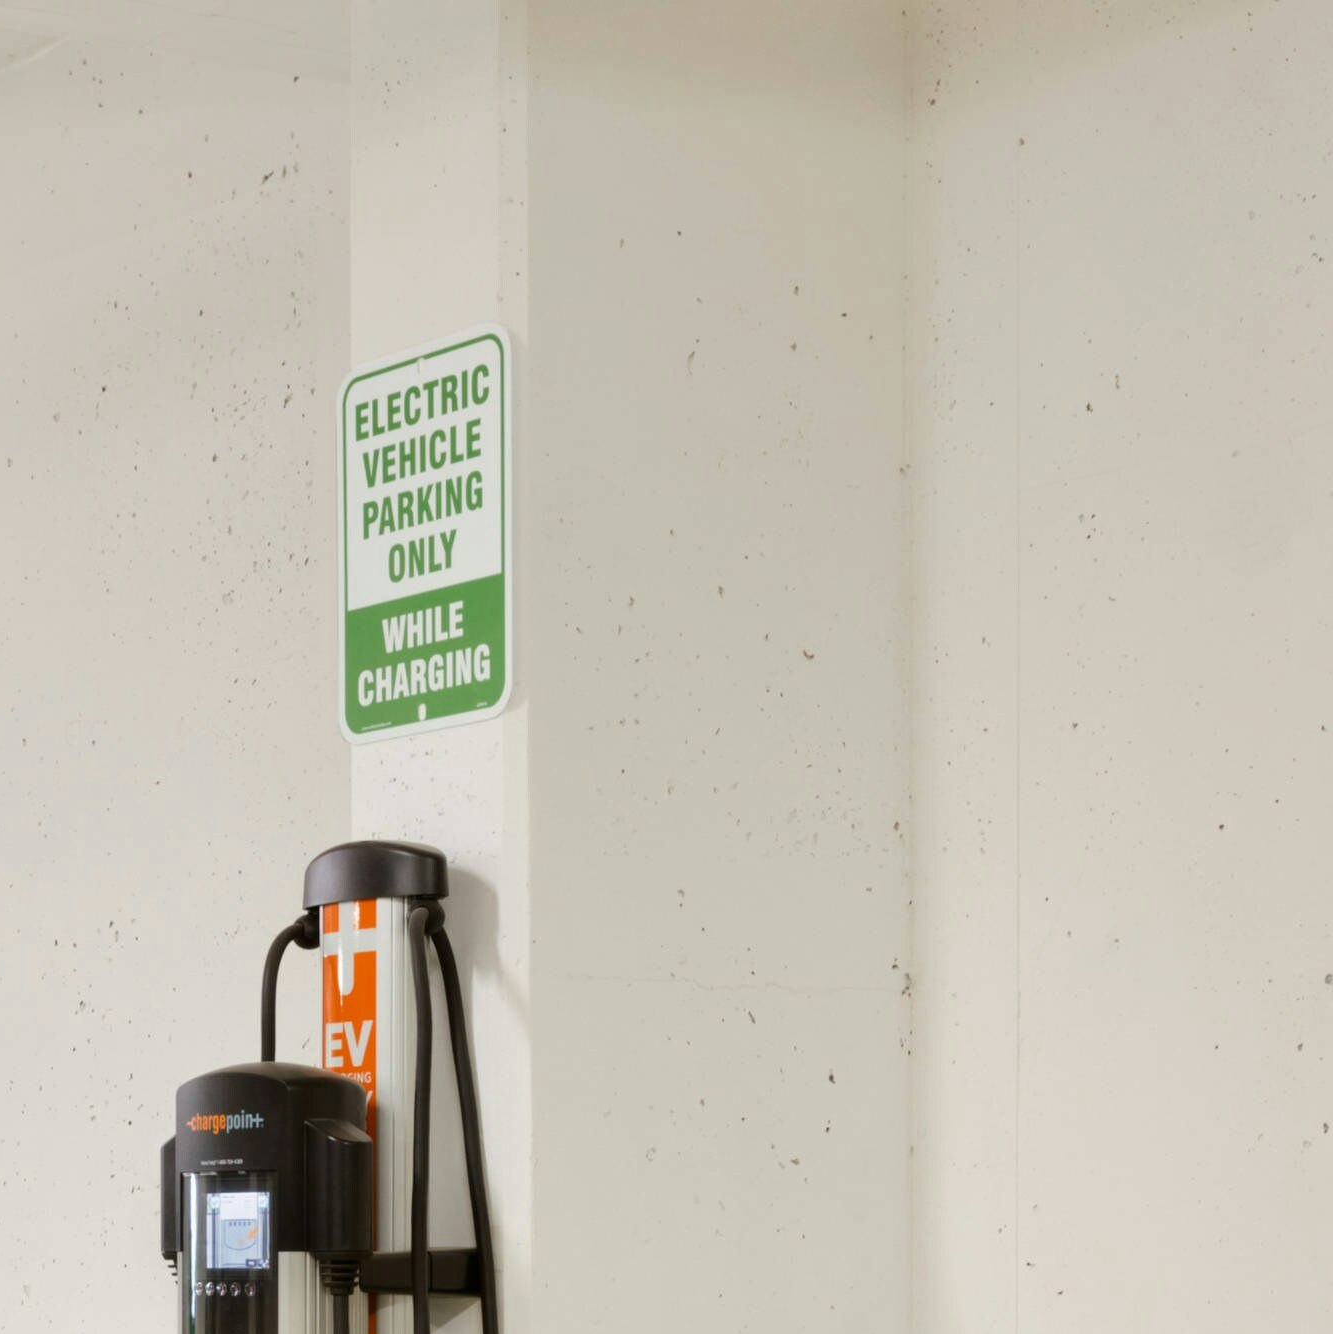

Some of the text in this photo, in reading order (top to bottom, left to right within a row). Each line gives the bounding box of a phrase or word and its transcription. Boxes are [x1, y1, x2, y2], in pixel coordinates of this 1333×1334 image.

[355, 364, 490, 441] ELECTRIC
[363, 418, 482, 487] VEHICLE
[363, 470, 484, 539] PARKING
[388, 529, 457, 583] ONLY
[381, 601, 464, 653] WHILE
[357, 642, 491, 707] CHARGING
[326, 1020, 373, 1067] EV
